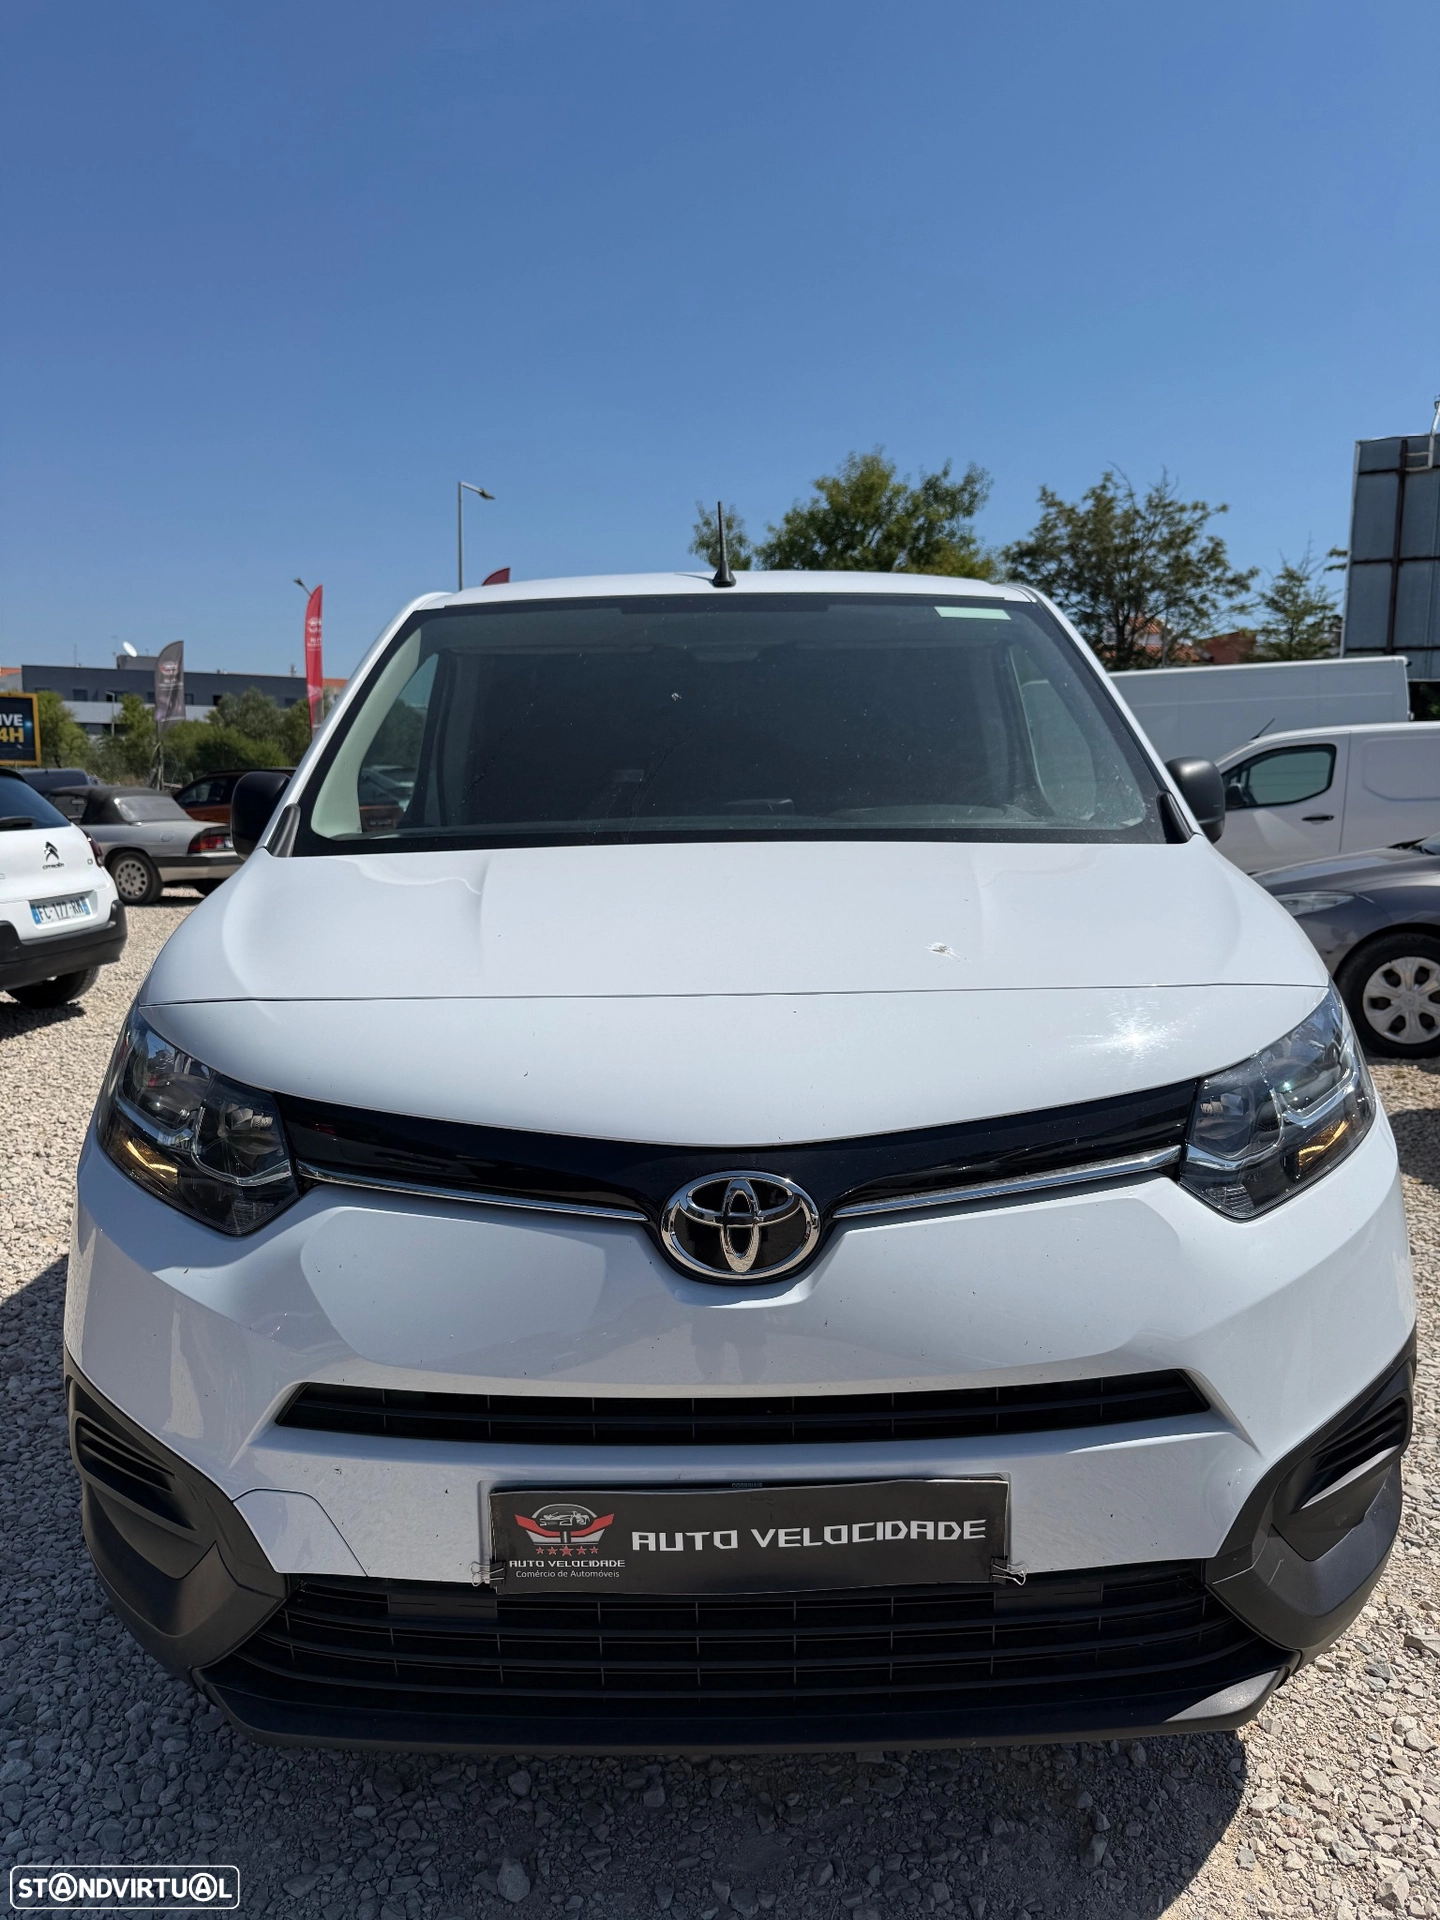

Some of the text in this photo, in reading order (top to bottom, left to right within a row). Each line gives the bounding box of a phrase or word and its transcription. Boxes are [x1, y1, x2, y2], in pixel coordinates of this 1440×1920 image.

[632, 1519, 986, 1551] AUTO VELOCIDADE
[509, 1559, 626, 1568] AUTO VELOCIDADE
[515, 1569, 620, 1578] Comércio de Automóveis
